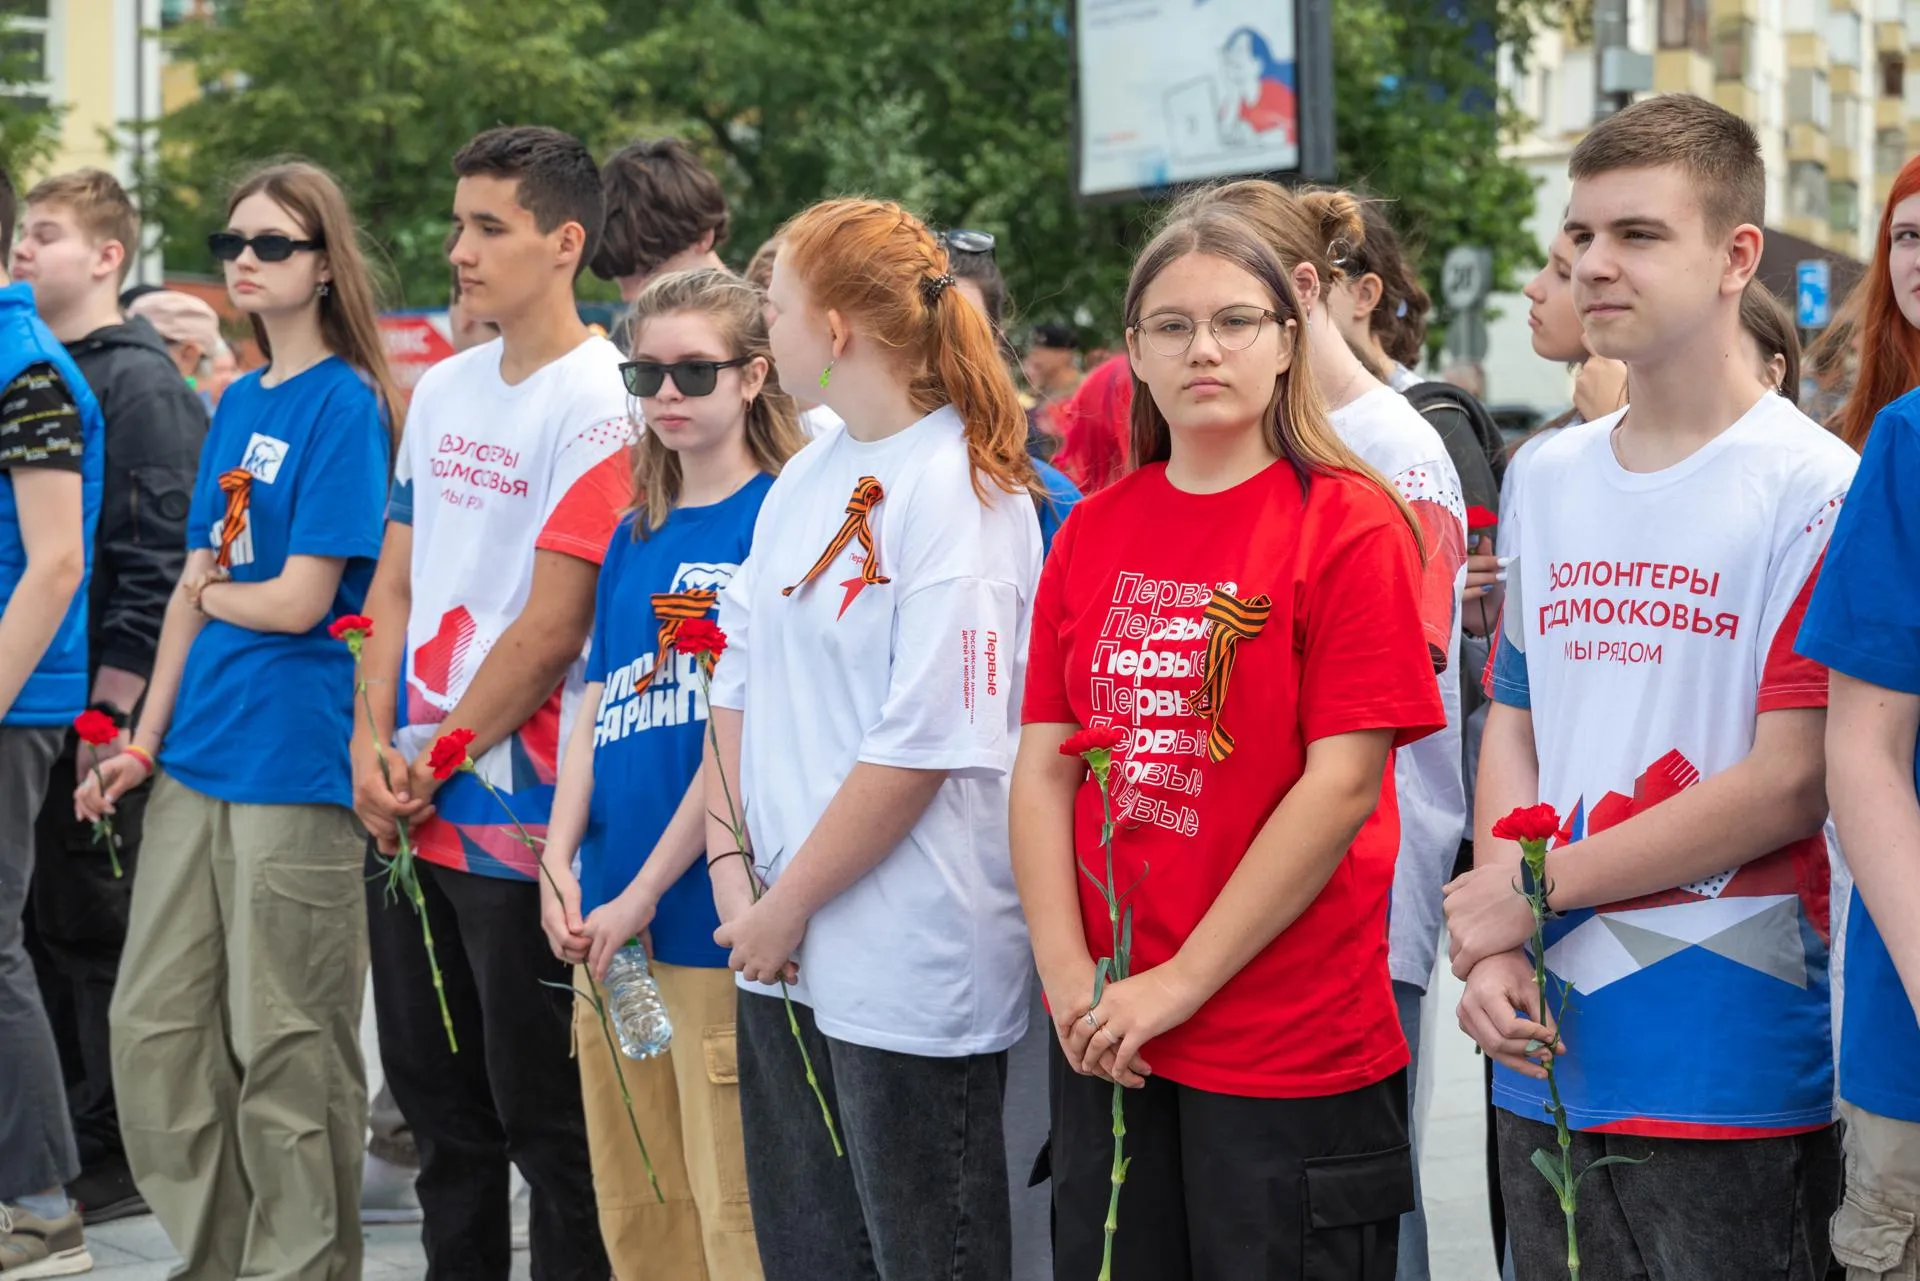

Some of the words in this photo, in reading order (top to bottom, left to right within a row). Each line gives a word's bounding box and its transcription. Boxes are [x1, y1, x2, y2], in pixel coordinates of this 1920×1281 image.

[1539, 598, 1740, 640] ПДМОСКОВЬЯ
[984, 631, 997, 696] Первые
[1564, 640, 1592, 661] МЫ
